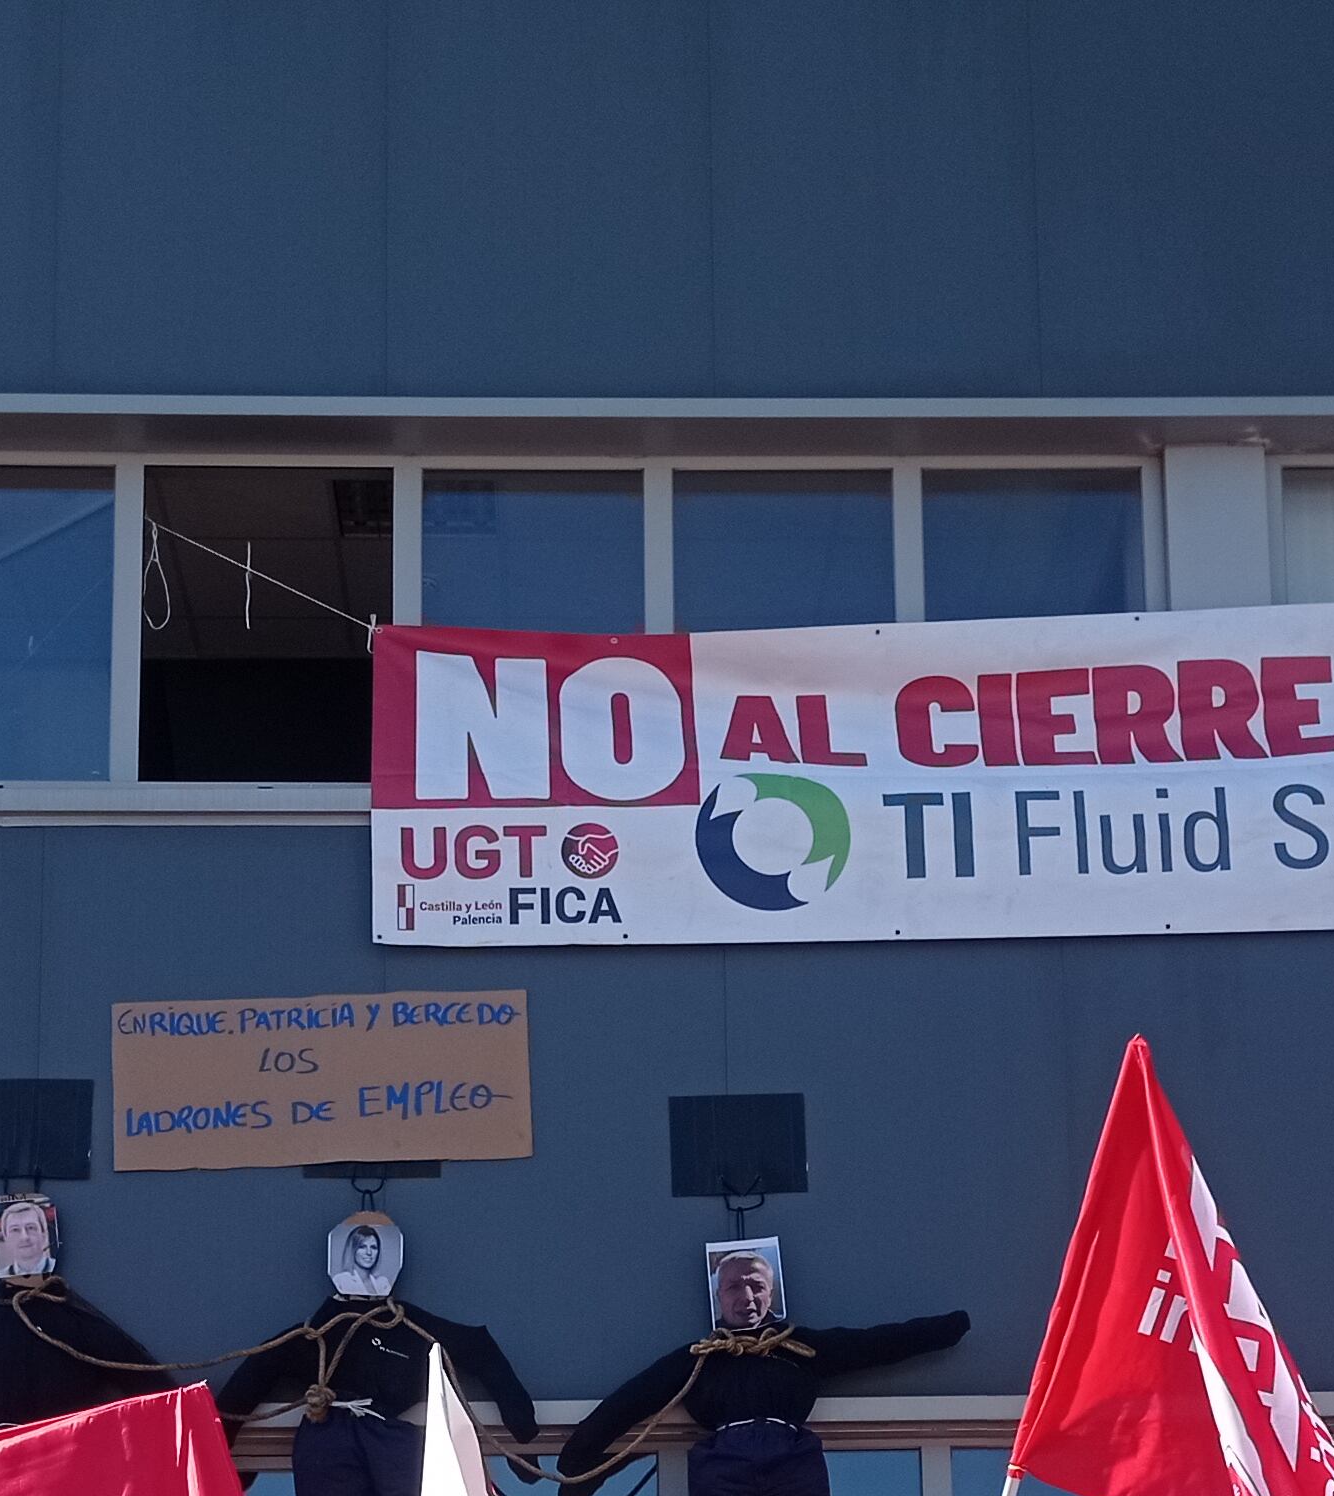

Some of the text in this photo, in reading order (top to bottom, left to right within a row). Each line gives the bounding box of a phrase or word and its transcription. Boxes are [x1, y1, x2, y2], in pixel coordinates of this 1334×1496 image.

[414, 650, 688, 802] NO
[720, 694, 869, 768] AL
[400, 823, 548, 881] UGT
[882, 790, 975, 879] TI
[1015, 785, 1233, 876] Fluid
[418, 899, 503, 914] Castilla y León
[452, 914, 503, 926] Palencia
[508, 886, 623, 926] FICA
[237, 1001, 355, 1035] PATRICIA
[392, 1000, 522, 1027] BERCEDO
[258, 1047, 319, 1074] LOS
[126, 1079, 514, 1138] LADRONES DE EMPLEO
